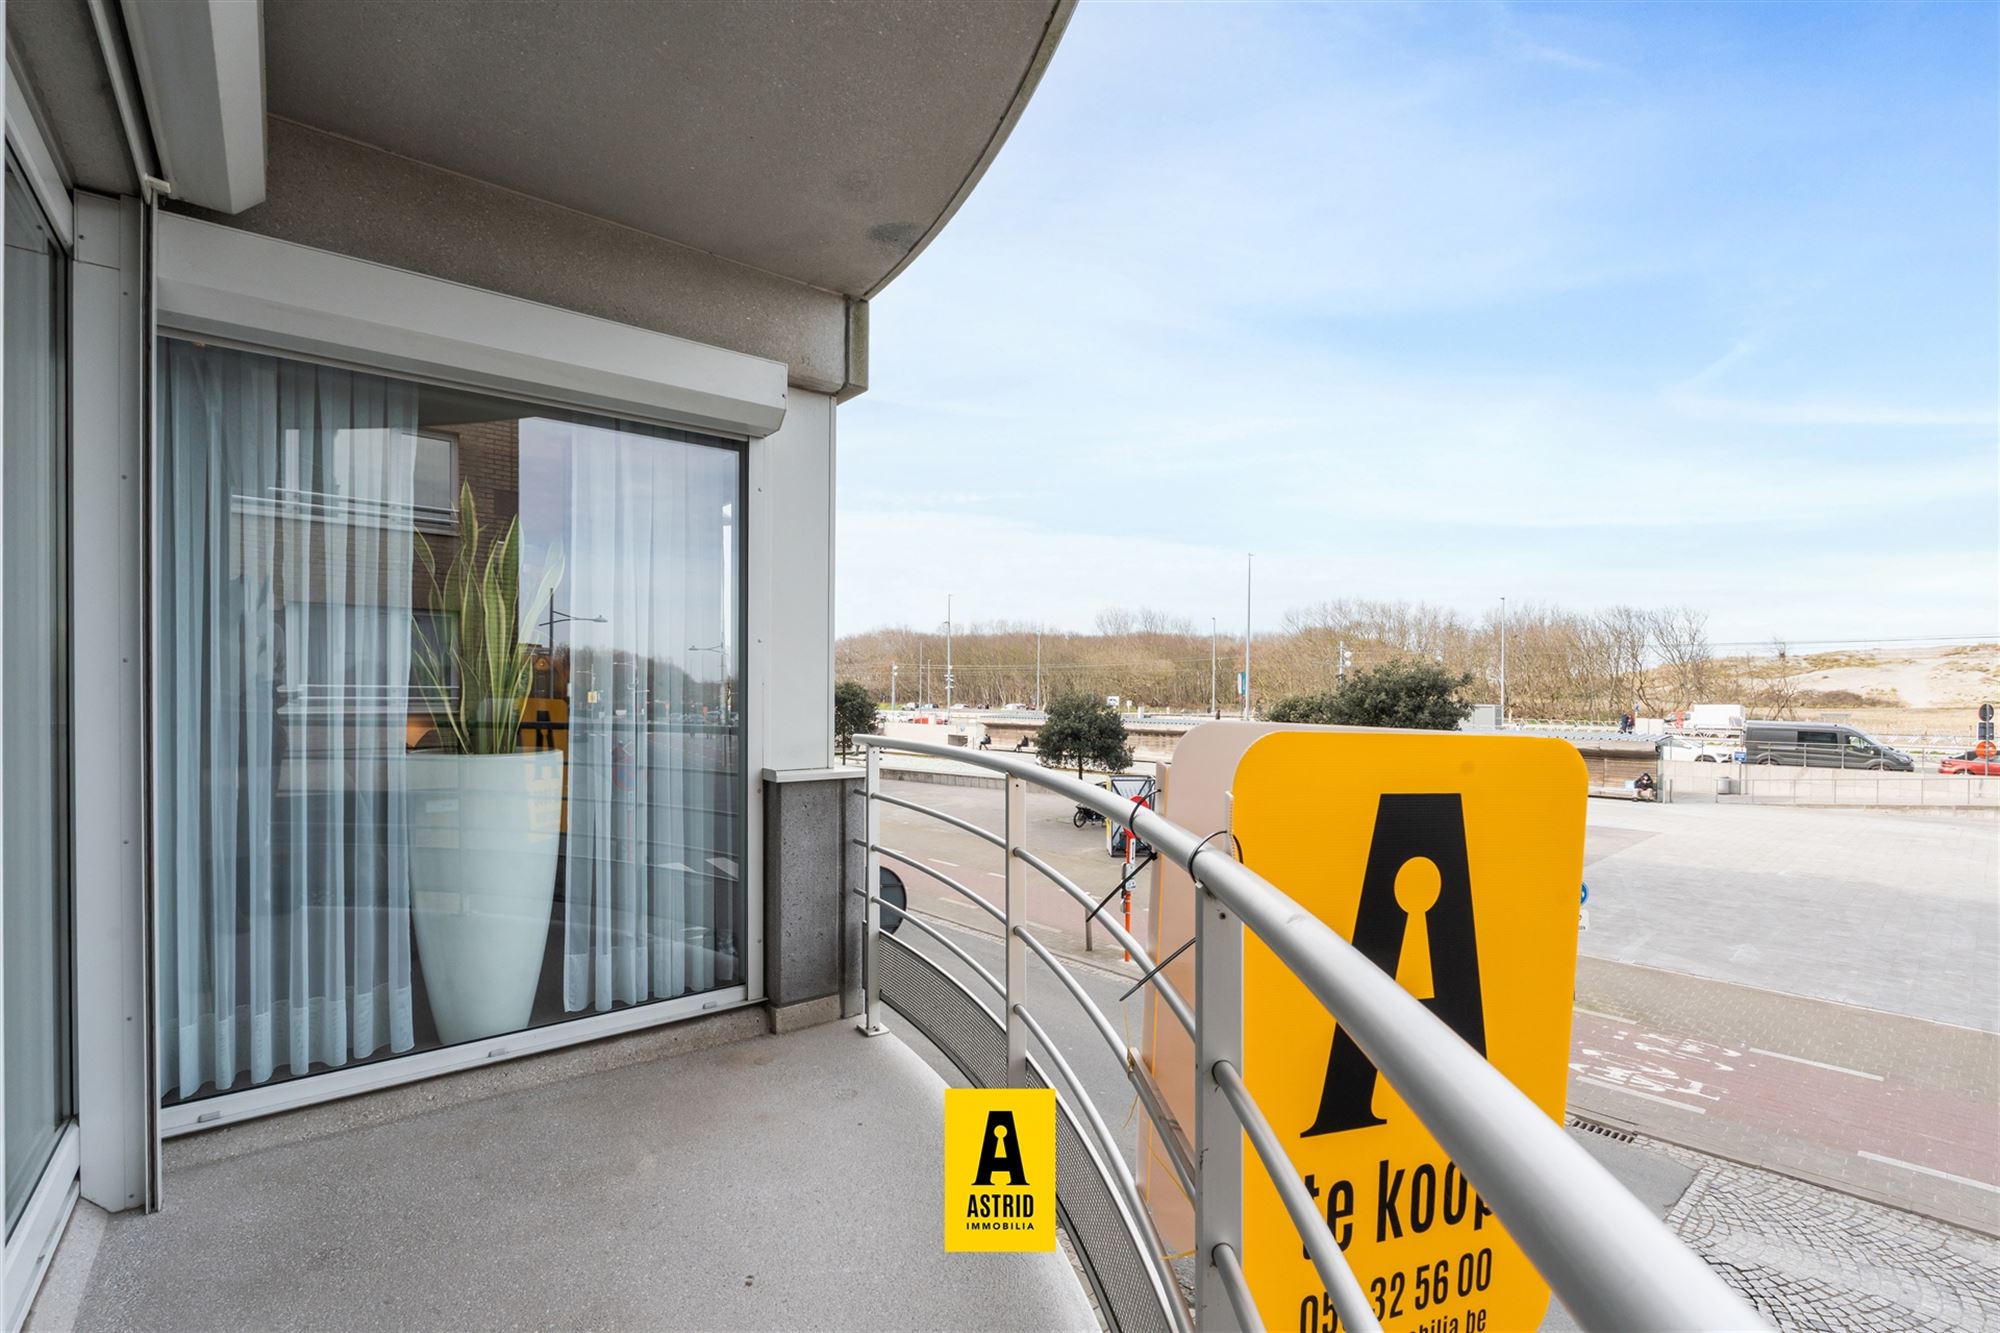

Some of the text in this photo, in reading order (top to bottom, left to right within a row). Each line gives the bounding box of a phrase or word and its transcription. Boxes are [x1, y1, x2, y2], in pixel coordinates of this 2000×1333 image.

[1300, 1247, 1493, 1333] 05 32 56 00
